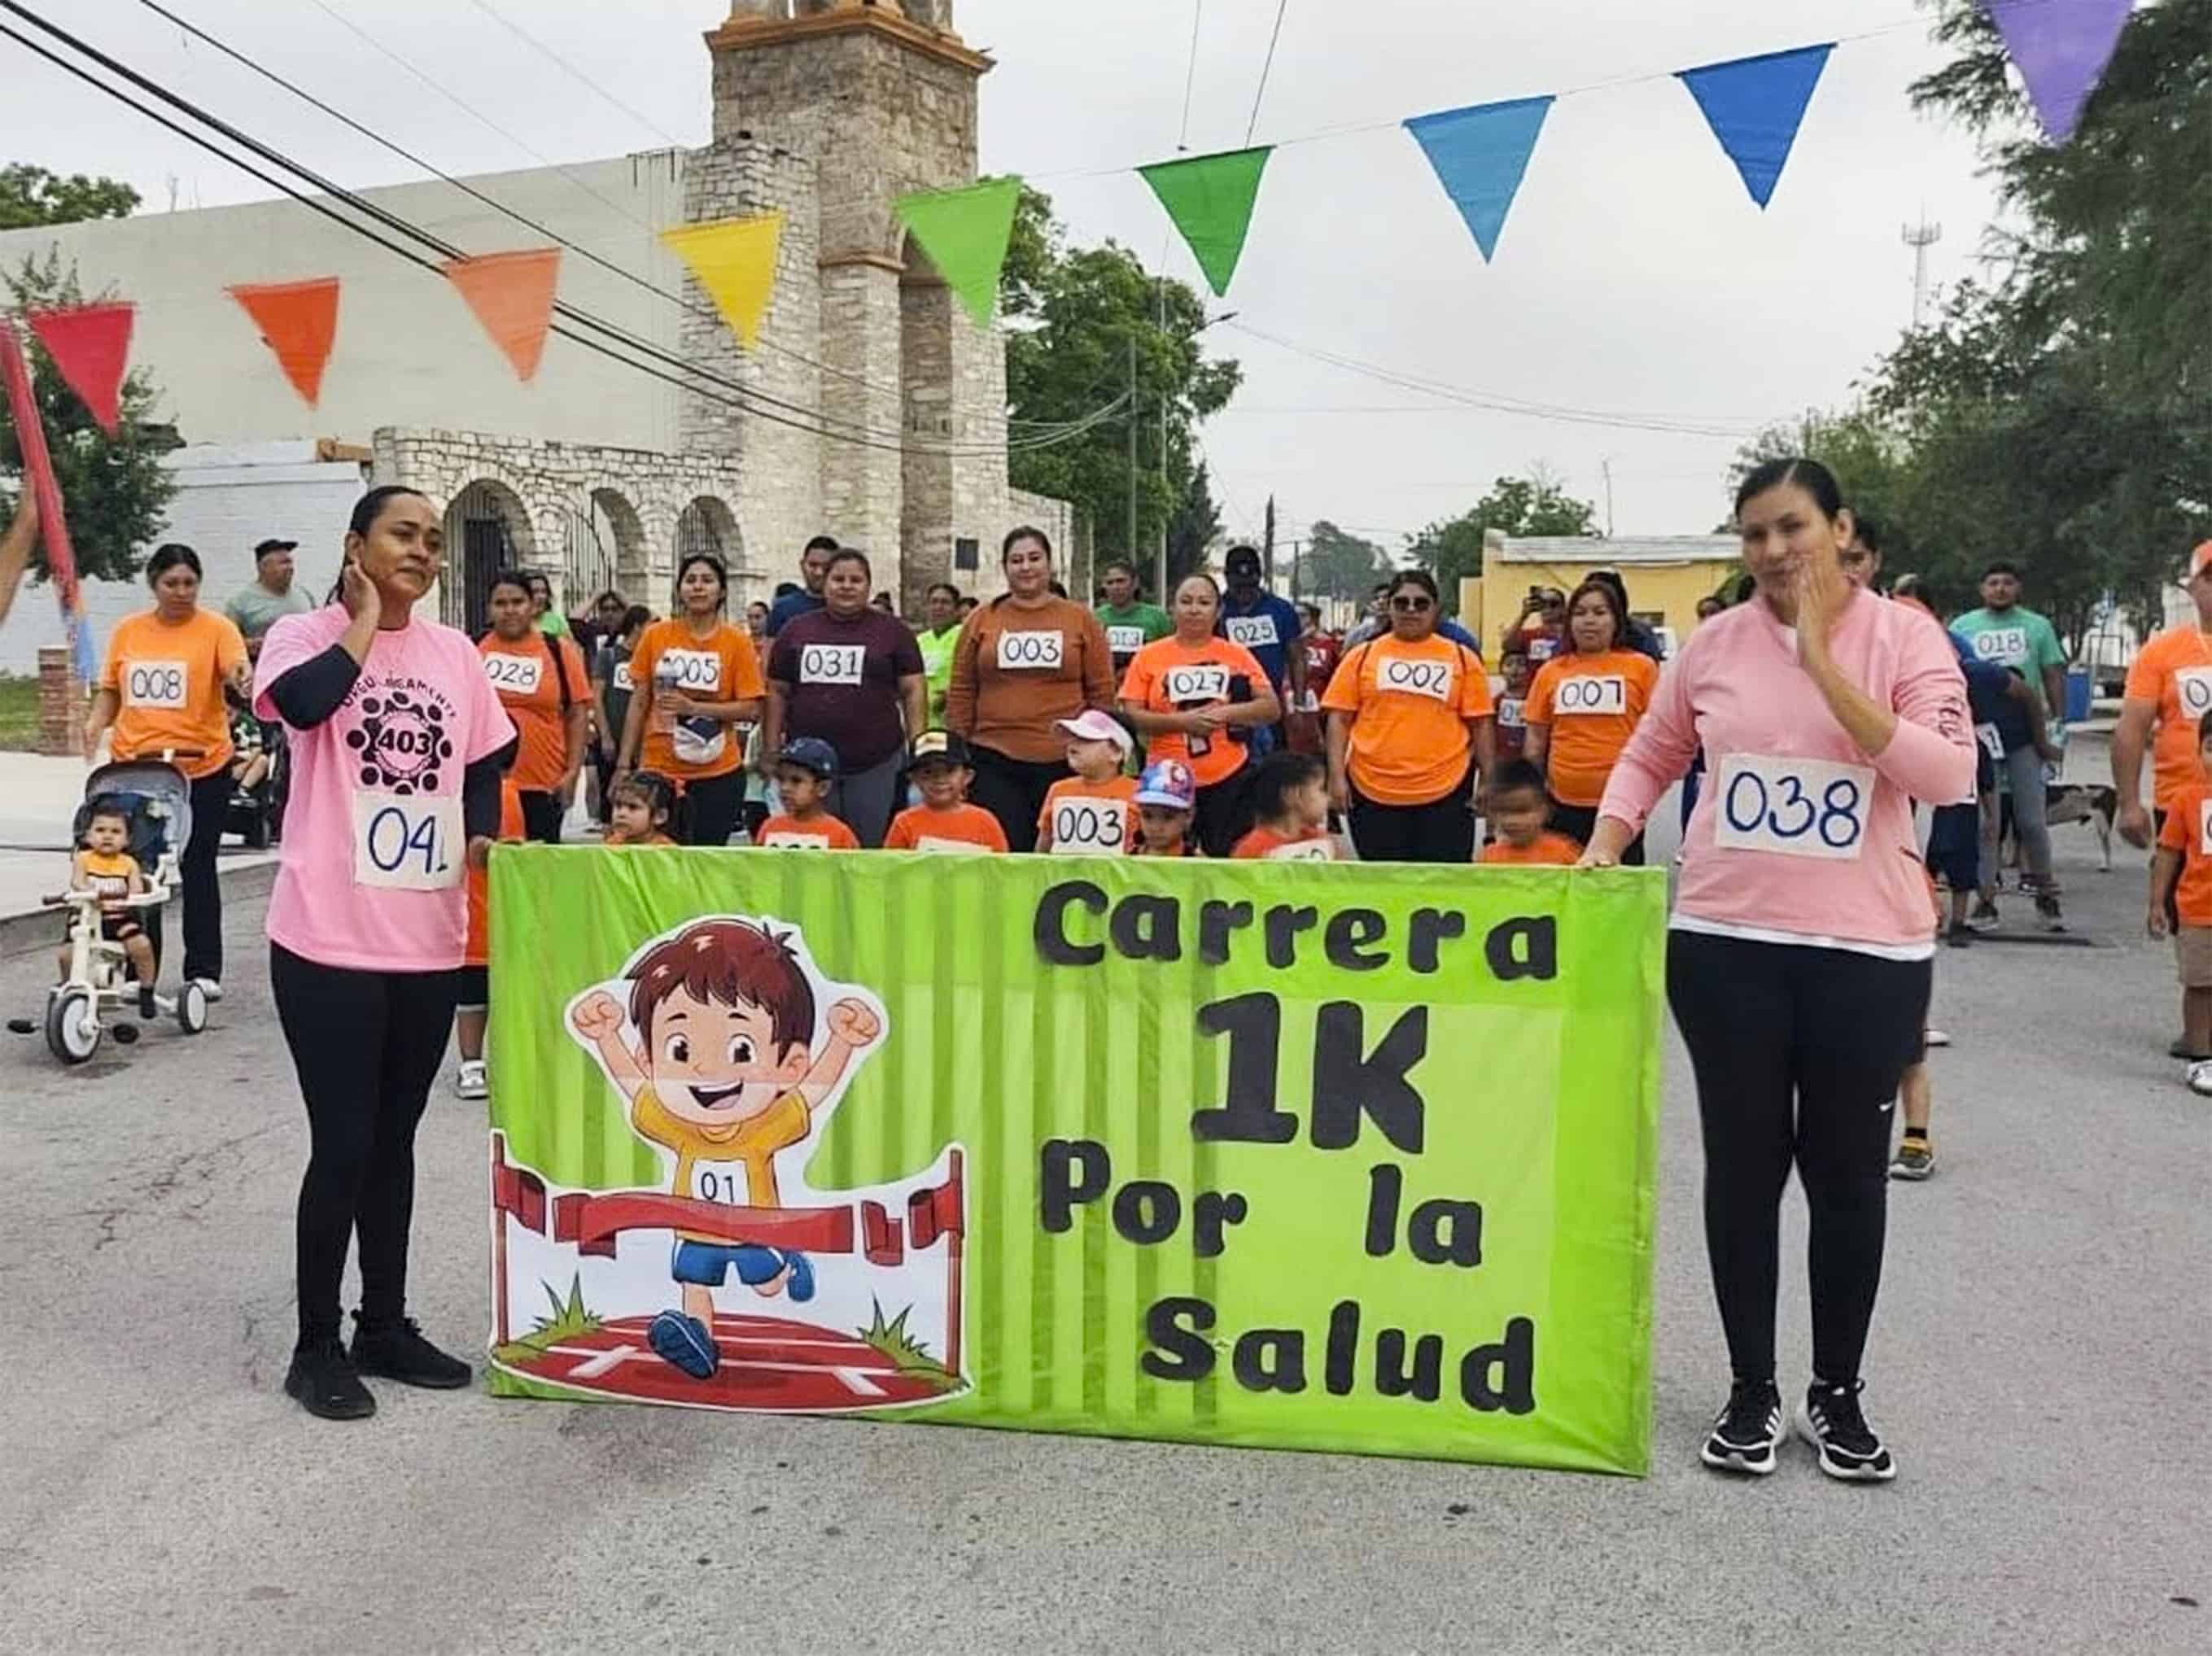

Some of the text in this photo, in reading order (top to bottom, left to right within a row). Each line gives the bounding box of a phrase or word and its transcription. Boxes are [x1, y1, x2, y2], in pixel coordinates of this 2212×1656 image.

[1233, 620, 1274, 643] 025
[1978, 631, 2023, 654] 018
[806, 649, 859, 678] 031
[1004, 637, 1059, 662] 003
[132, 668, 181, 700] 008
[484, 658, 536, 685] 028
[1174, 669, 1225, 694] 027
[1388, 660, 1447, 694] 002
[1561, 679, 1622, 707] 007
[378, 728, 431, 756] 403
[1057, 806, 1122, 846] 003
[1725, 771, 1861, 849] 038
[1034, 880, 1558, 981] Carrera
[1191, 991, 1429, 1155] 1K
[701, 1171, 736, 1205] 01
[1039, 1138, 1483, 1268] Por la
[1140, 1296, 1537, 1416] Salud
